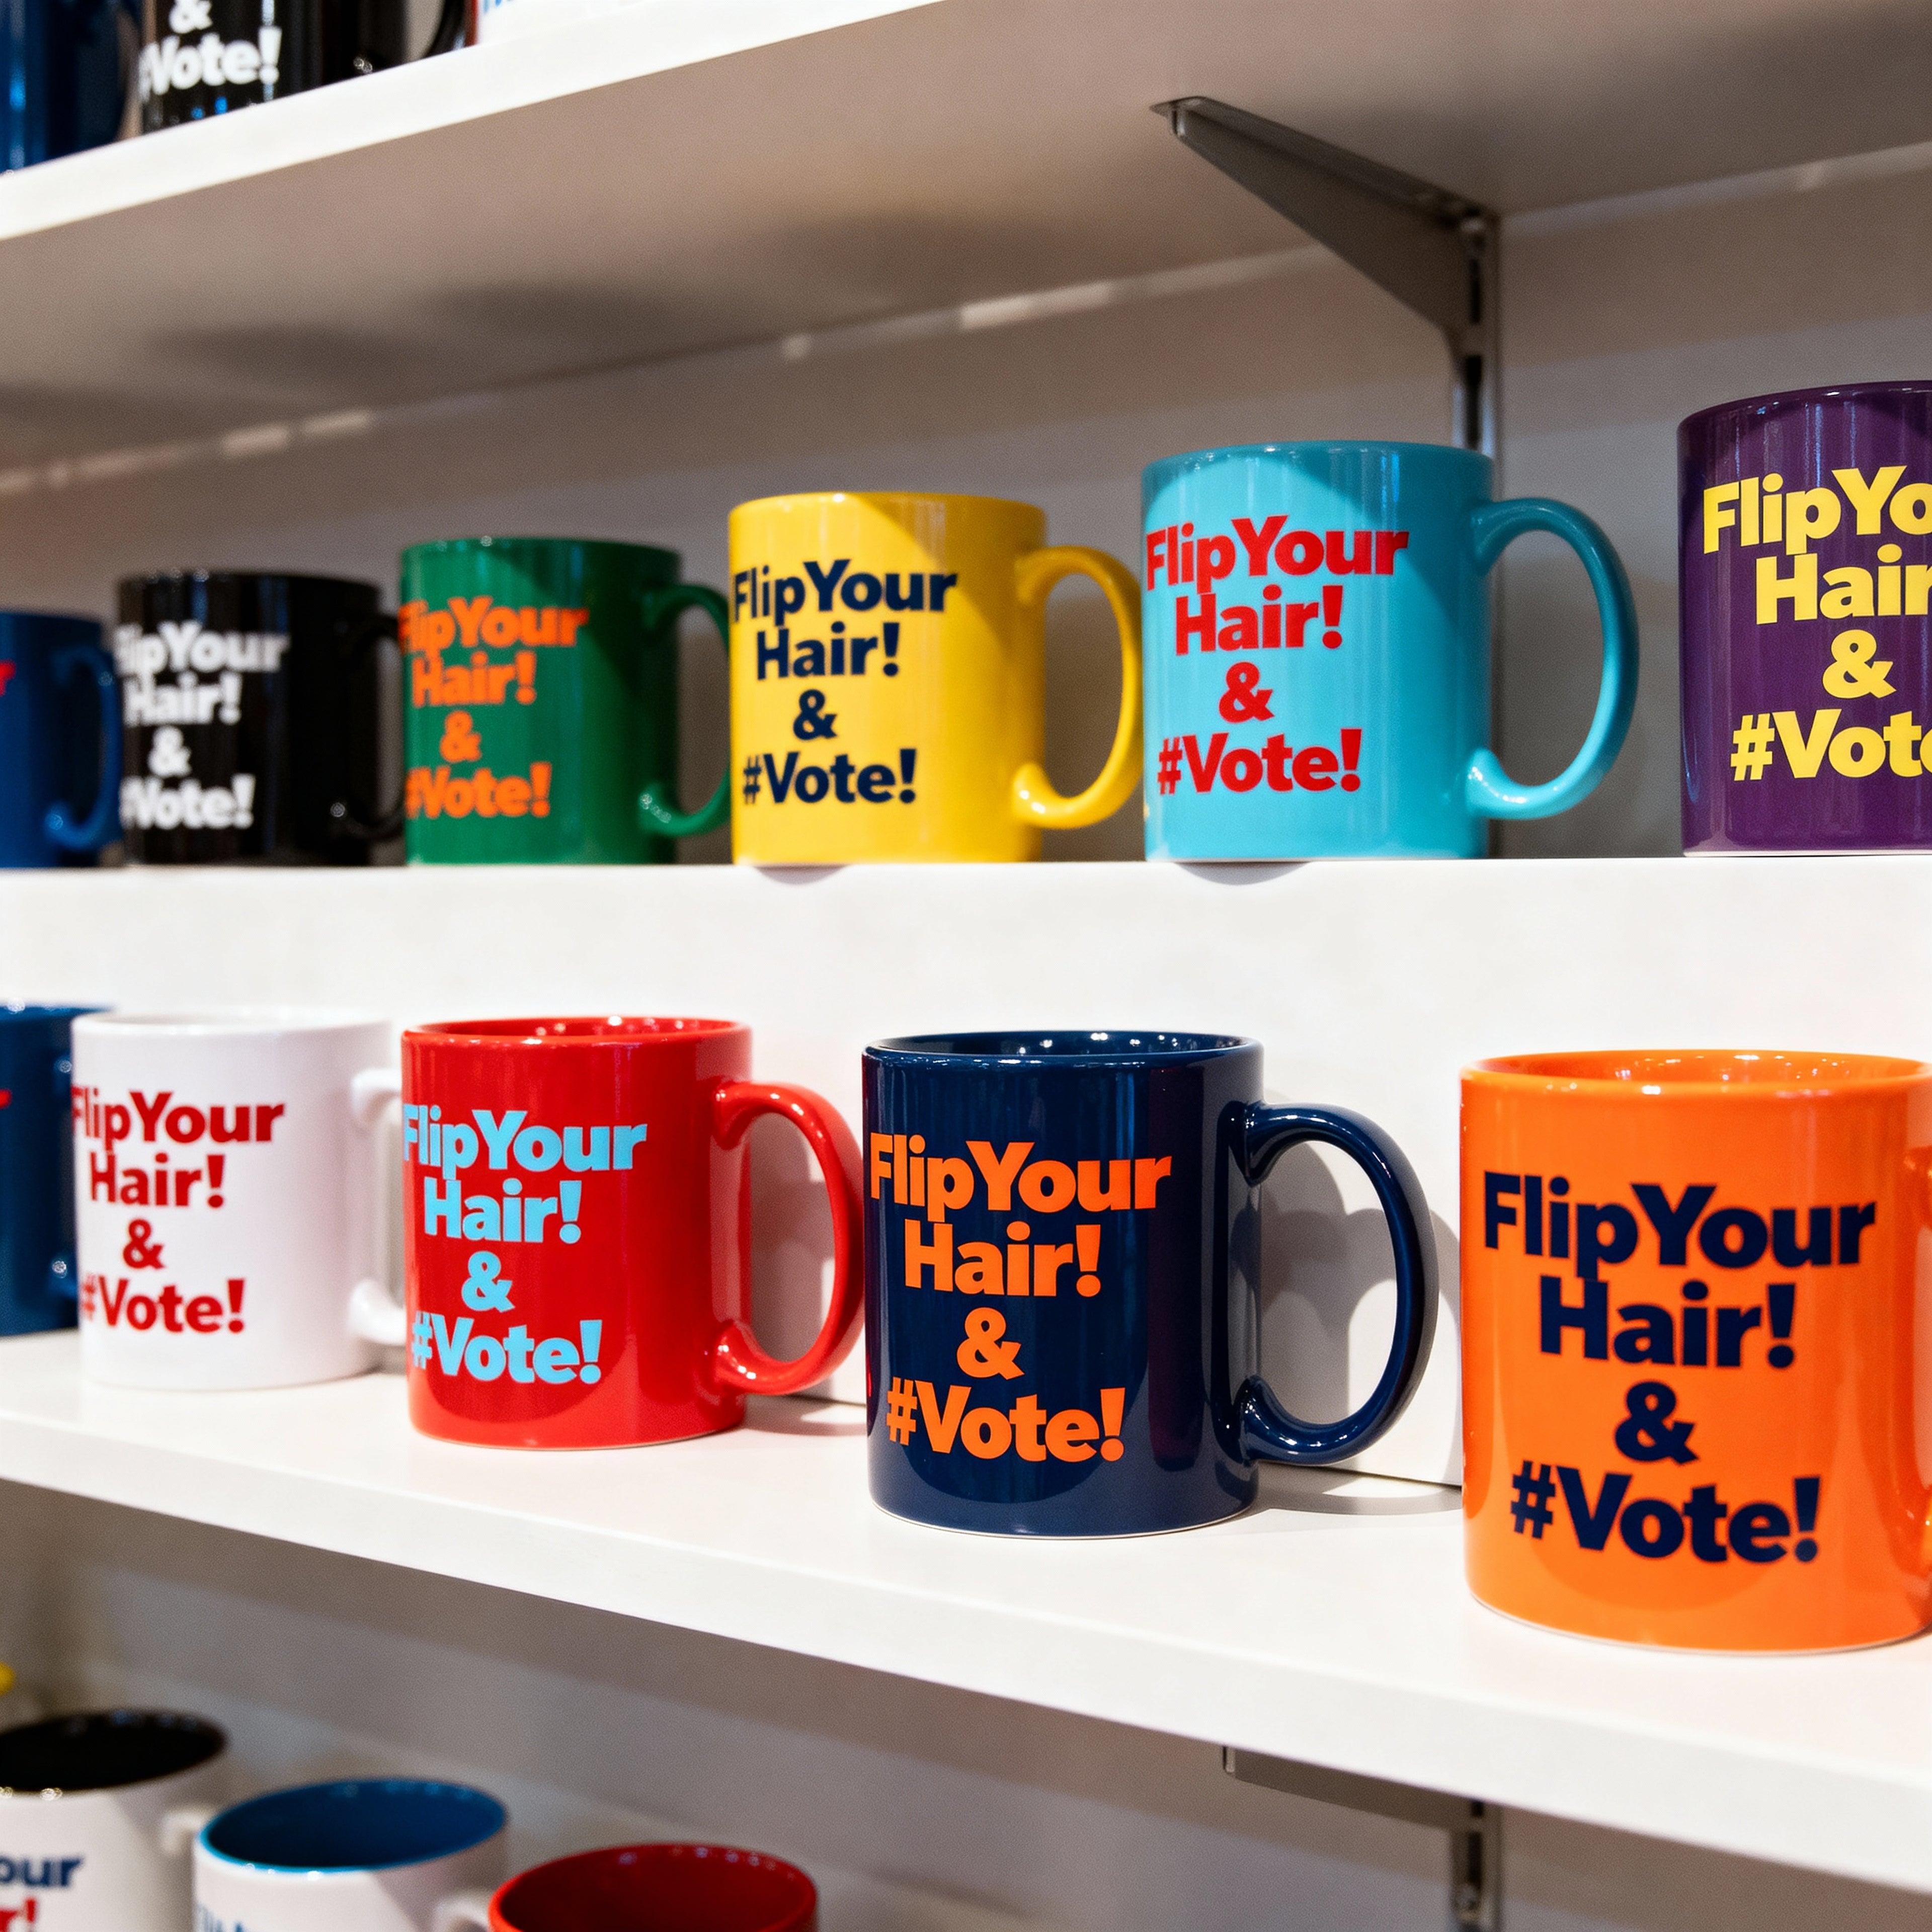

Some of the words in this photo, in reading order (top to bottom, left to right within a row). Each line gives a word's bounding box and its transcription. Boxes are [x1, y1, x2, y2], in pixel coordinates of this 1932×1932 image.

[1146, 515, 1410, 594] FlipYour
[734, 559, 958, 627] FlipYour
[1175, 584, 1343, 656] Hair!
[412, 650, 537, 708] Hair!
[757, 621, 900, 680] Hair!
[1822, 629, 1897, 698] &
[123, 671, 242, 727] Hair!
[793, 689, 838, 741] &
[1218, 661, 1275, 723] &
[147, 726, 192, 776] &
[439, 710, 481, 763] &
[1157, 728, 1362, 795] #Vote!
[1731, 708, 1932, 781] #Vot
[743, 748, 917, 805] #Vote!
[404, 1103, 648, 1180] FlipYour
[90, 1151, 226, 1209] Hair!
[424, 1176, 582, 1244] Hair!
[870, 1132, 1172, 1223] FlipYour
[122, 1218, 166, 1269] &
[905, 1218, 1101, 1297] Hair!
[1484, 1170, 1877, 1278] FlipYour
[461, 1250, 515, 1313] &
[412, 1311, 603, 1385] #Vote!
[956, 1307, 1025, 1380] &
[1540, 1274, 1796, 1369] Hair!
[886, 1377, 1125, 1462] #Vote!
[1614, 1381, 1700, 1466] &
[1510, 1460, 1821, 1563] #Vote!
